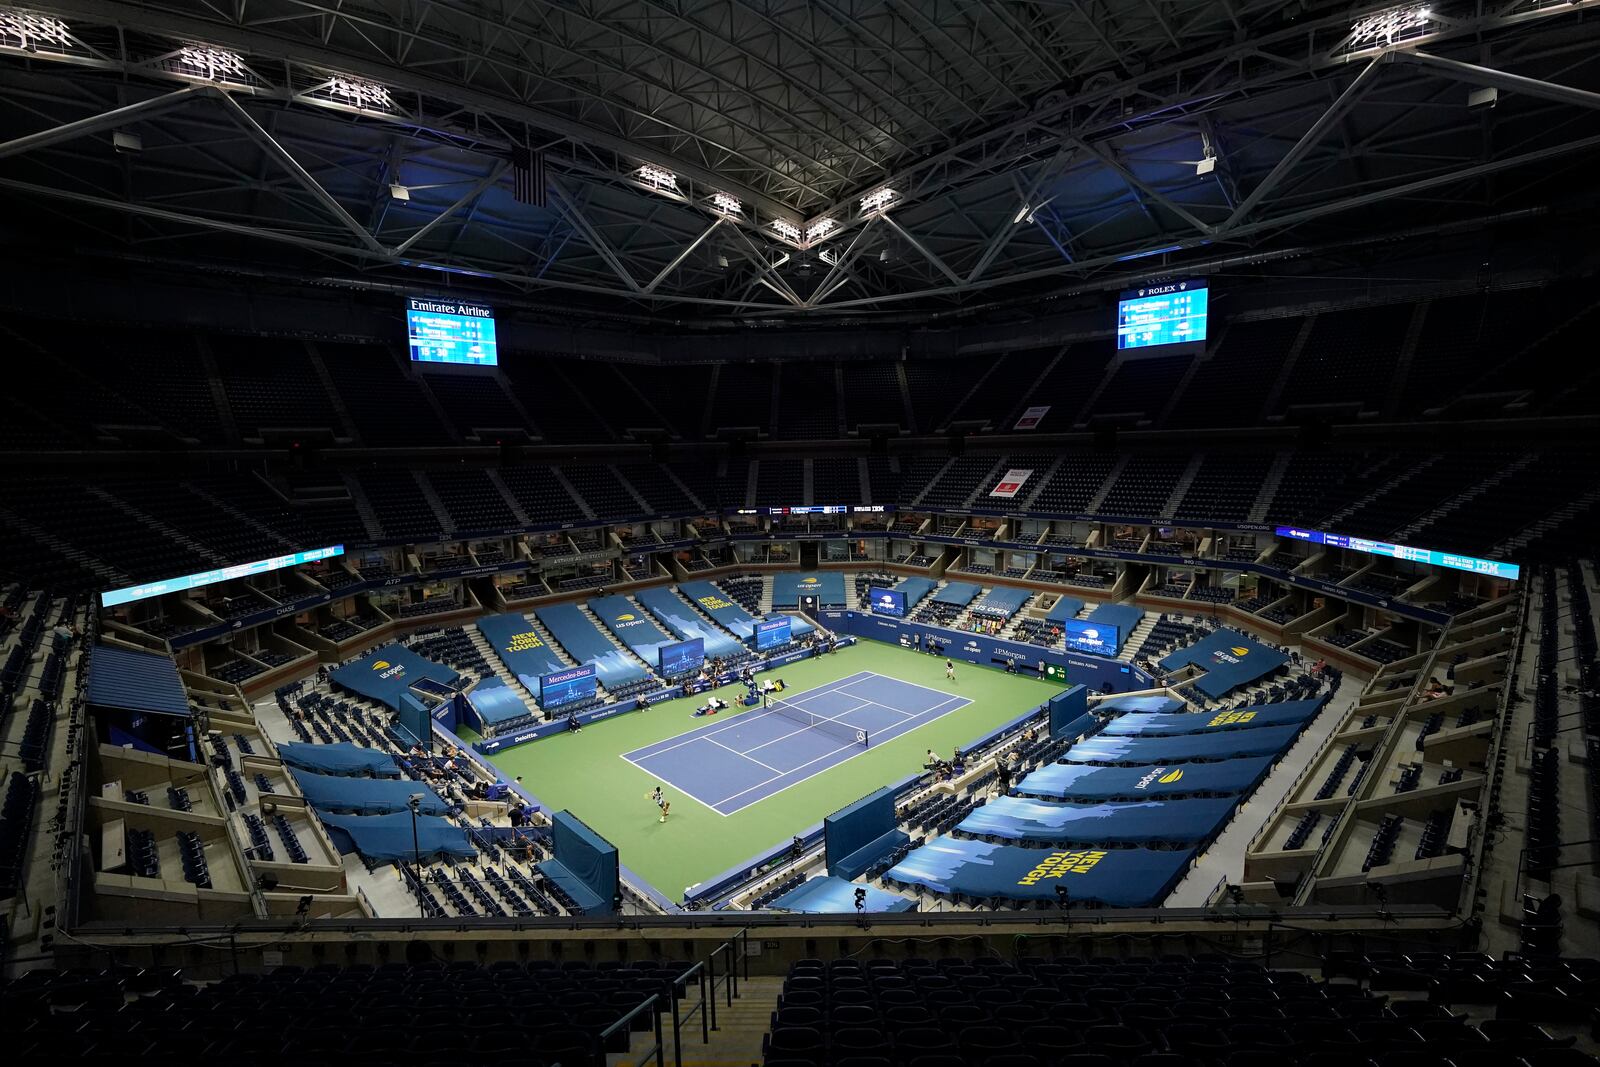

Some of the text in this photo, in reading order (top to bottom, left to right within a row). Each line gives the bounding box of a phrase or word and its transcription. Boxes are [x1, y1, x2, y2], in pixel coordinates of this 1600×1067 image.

[1148, 285, 1176, 295] ROLEX
[411, 300, 490, 318] Emirates Airline
[1475, 560, 1499, 575] IBM
[385, 578, 401, 586] ATP
[276, 605, 296, 616] CHASE
[975, 604, 1010, 616] US OPEN
[625, 619, 645, 628] open
[511, 631, 536, 640] NEW
[505, 642, 544, 652] TOUGH
[509, 637, 539, 646] YORK
[1086, 638, 1104, 646] open
[993, 648, 1026, 660] J.P.Morgan
[387, 664, 405, 675] open
[548, 669, 590, 684] Mercedes-Benz
[514, 732, 539, 742] Deloitte.
[1134, 774, 1157, 790] open
[1044, 851, 1089, 878] YORK
[1070, 851, 1108, 874] NEW
[1017, 851, 1071, 886] TOUGH
